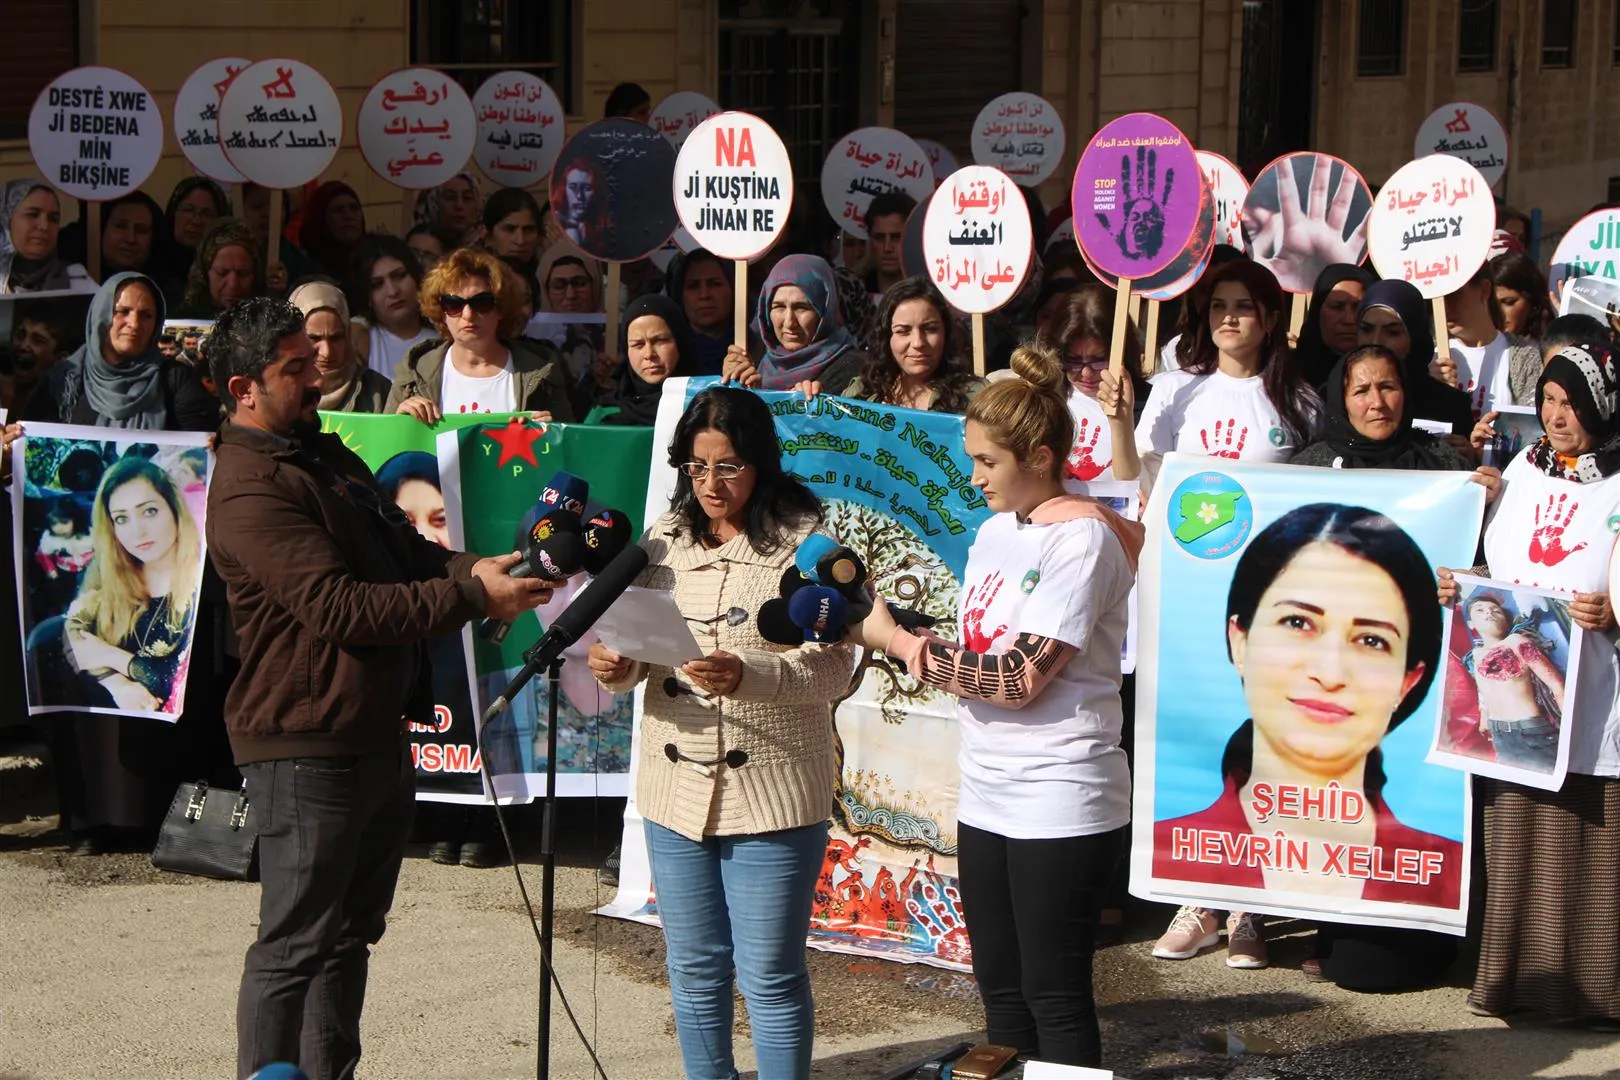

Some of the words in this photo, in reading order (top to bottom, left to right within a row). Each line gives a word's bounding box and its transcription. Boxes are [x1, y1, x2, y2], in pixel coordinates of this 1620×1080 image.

[49, 85, 104, 109] DESTÊ
[108, 90, 146, 111] XWE
[49, 109, 65, 132] Jİ
[70, 114, 139, 136] BEDENA
[79, 136, 111, 160] MİN
[716, 128, 756, 167] NA
[845, 140, 882, 168] حياة
[1117, 138, 1130, 147] ضد
[684, 170, 699, 198] Jİ
[706, 171, 780, 205] KUŞTİNA
[953, 178, 1005, 215] أوقفوا
[1094, 179, 1116, 189] STOP
[1432, 177, 1474, 207] المرأة
[1387, 189, 1427, 214] حياة
[695, 203, 747, 231] JİNAN
[753, 209, 774, 232] RE
[949, 219, 1002, 245] العنف
[935, 254, 976, 290] المرأة
[981, 259, 1015, 291] على
[1403, 255, 1459, 285] الحياة
[482, 444, 492, 456] Y
[541, 442, 550, 454] J
[513, 465, 523, 477] P
[1251, 779, 1366, 824] ŞEHÎD
[1172, 827, 1309, 874] HEVRÎN
[1321, 841, 1443, 885] XELEF
